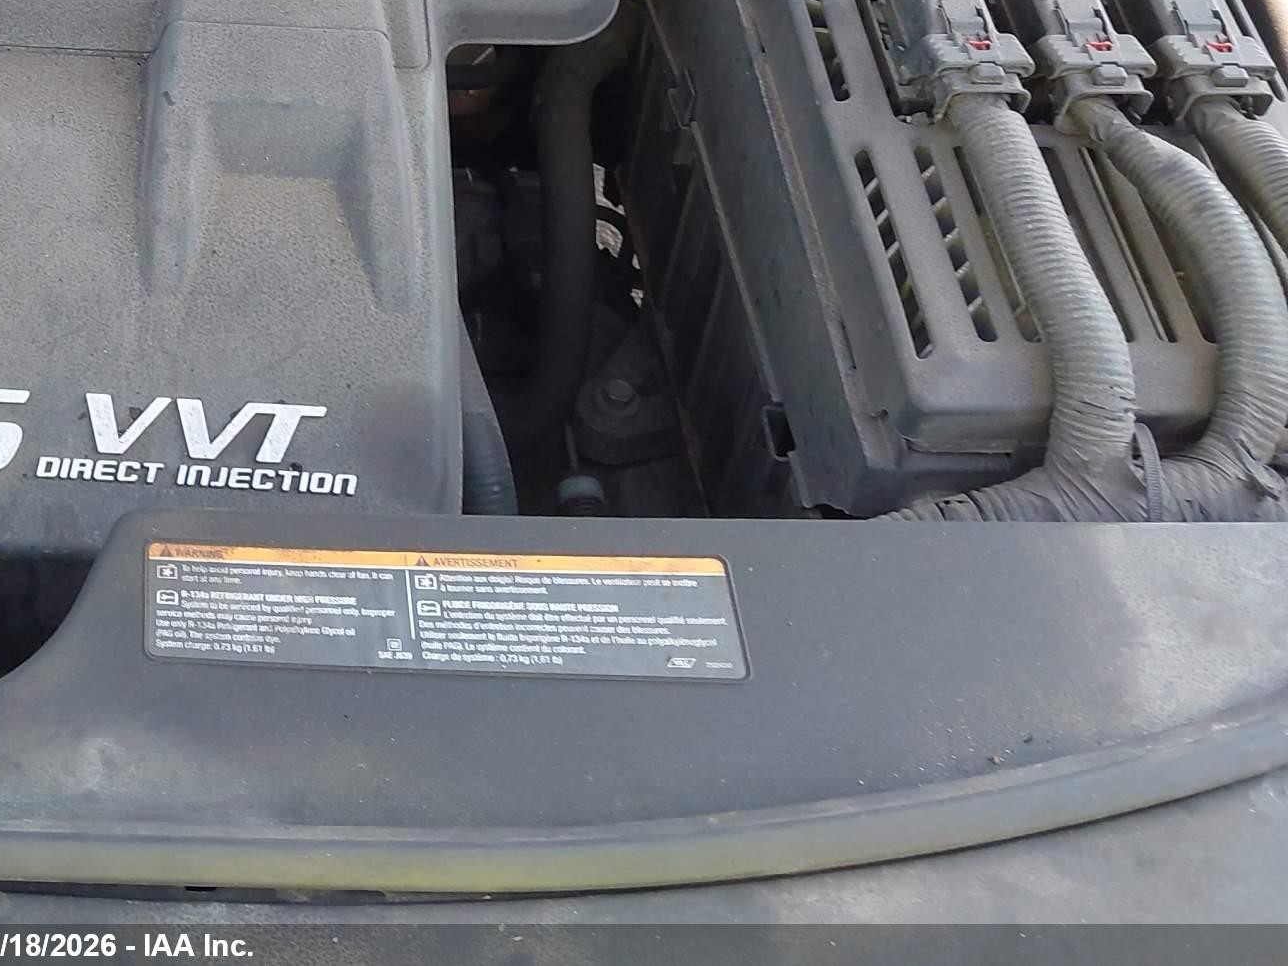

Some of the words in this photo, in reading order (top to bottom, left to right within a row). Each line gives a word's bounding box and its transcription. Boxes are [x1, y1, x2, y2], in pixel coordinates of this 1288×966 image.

[85, 392, 328, 464] VVT
[35, 456, 165, 485] DIRECT
[176, 464, 359, 496] INJECTION
[434, 557, 518, 569] AVERTISSEMENT
